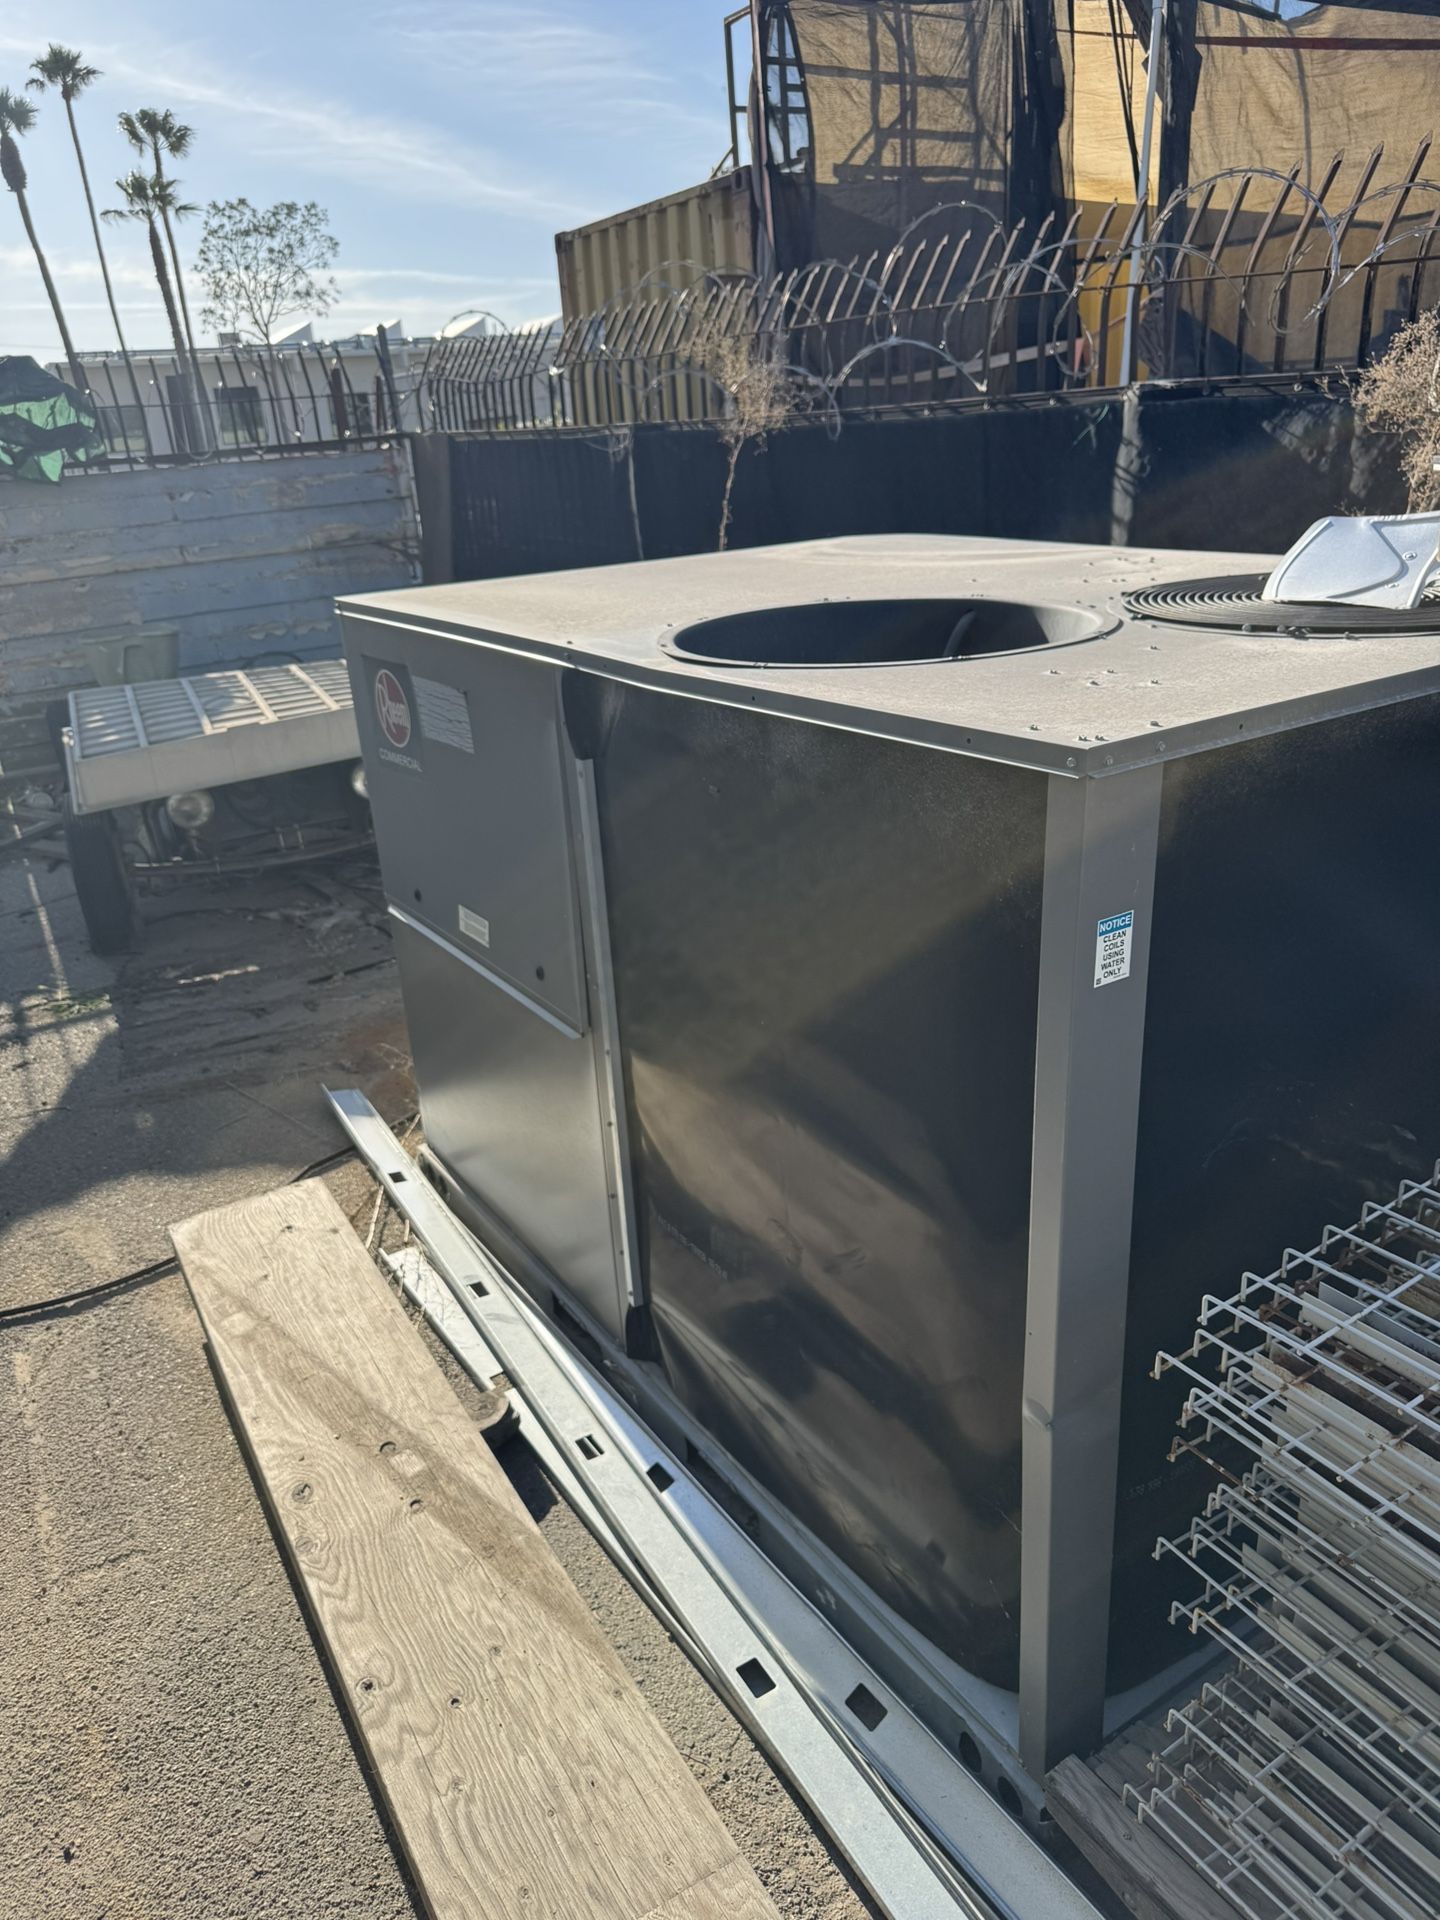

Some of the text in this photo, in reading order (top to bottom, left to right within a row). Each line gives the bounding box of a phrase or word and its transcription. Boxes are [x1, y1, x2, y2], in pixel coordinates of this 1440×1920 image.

[378, 748, 423, 772] COMMERCIAL
[1099, 915, 1132, 932] NOTICE
[1103, 929, 1126, 943] CLEAN
[1104, 939, 1125, 952] COILS
[1103, 949, 1124, 961] USING
[1101, 957, 1125, 970] WATER
[1103, 967, 1121, 978] ONLY
